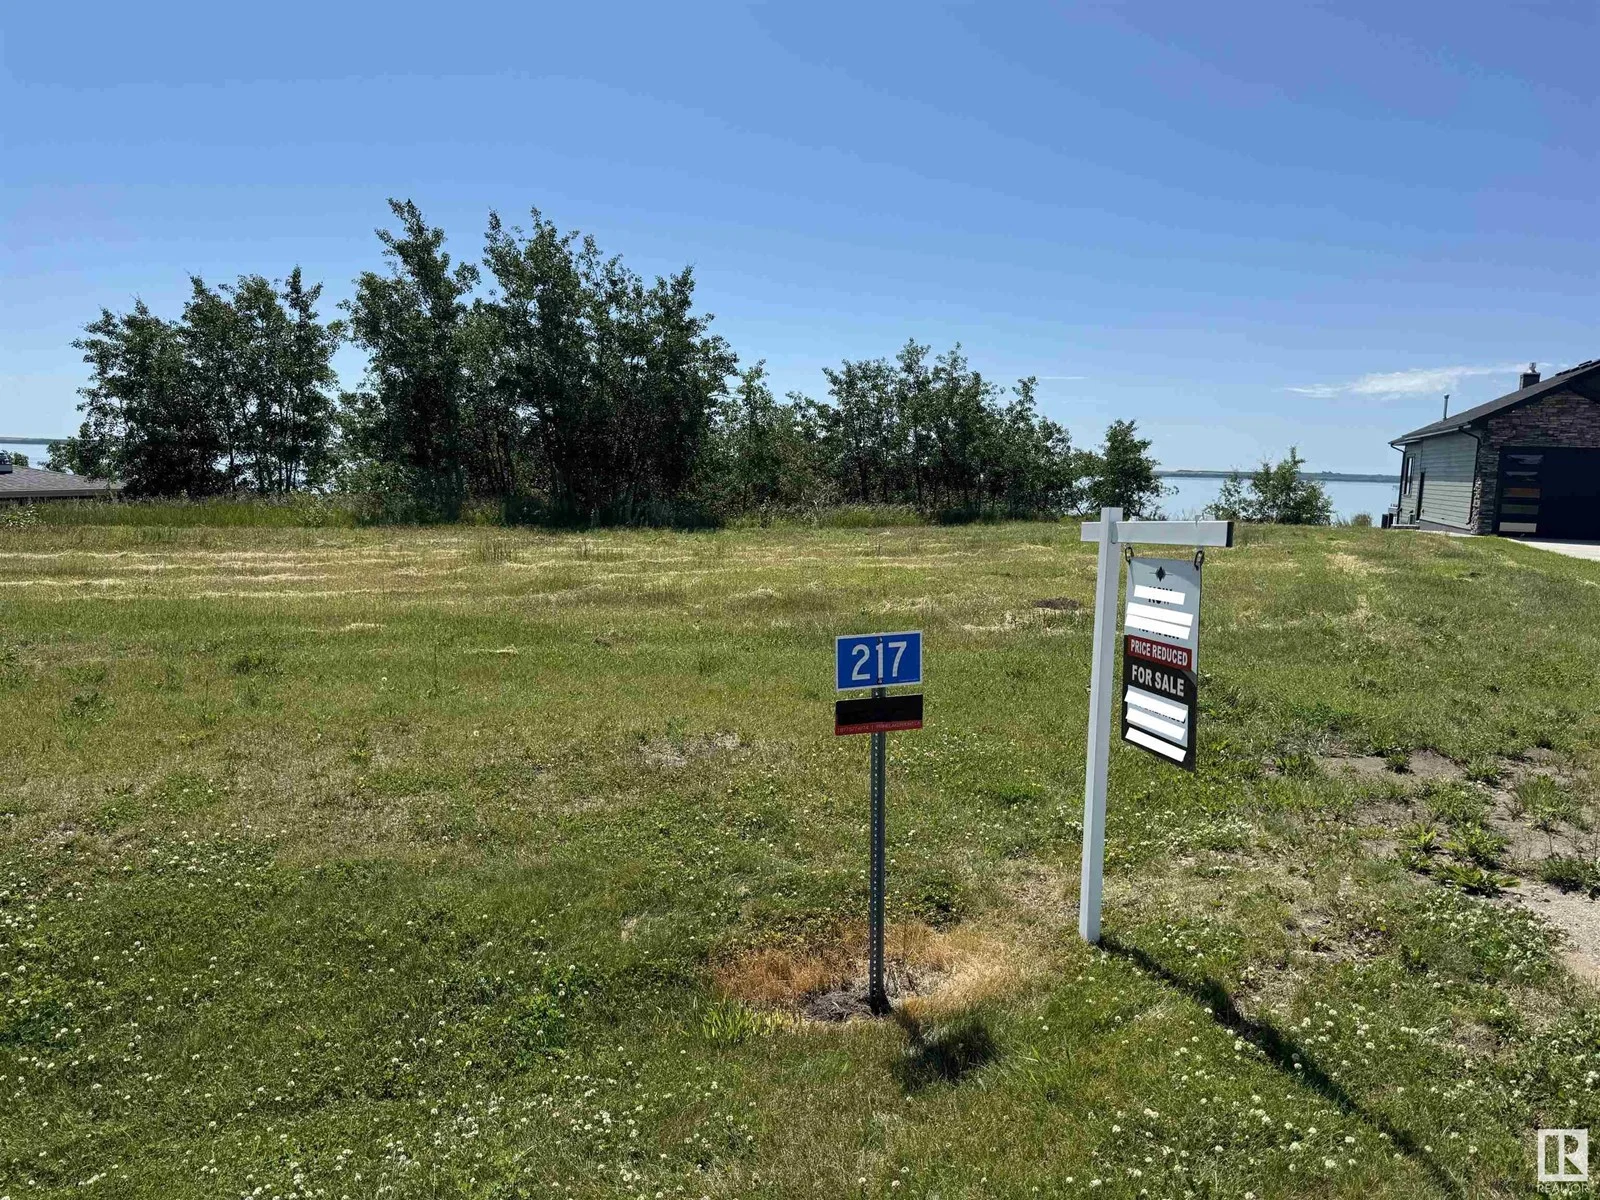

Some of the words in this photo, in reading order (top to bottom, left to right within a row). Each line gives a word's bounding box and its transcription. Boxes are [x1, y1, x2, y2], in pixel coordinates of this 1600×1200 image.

[851, 641, 907, 681] 217
[1130, 639, 1151, 657] PRICE
[1152, 644, 1188, 666] REDUCED
[1131, 664, 1153, 687] FOR
[1154, 671, 1185, 697] SALE
